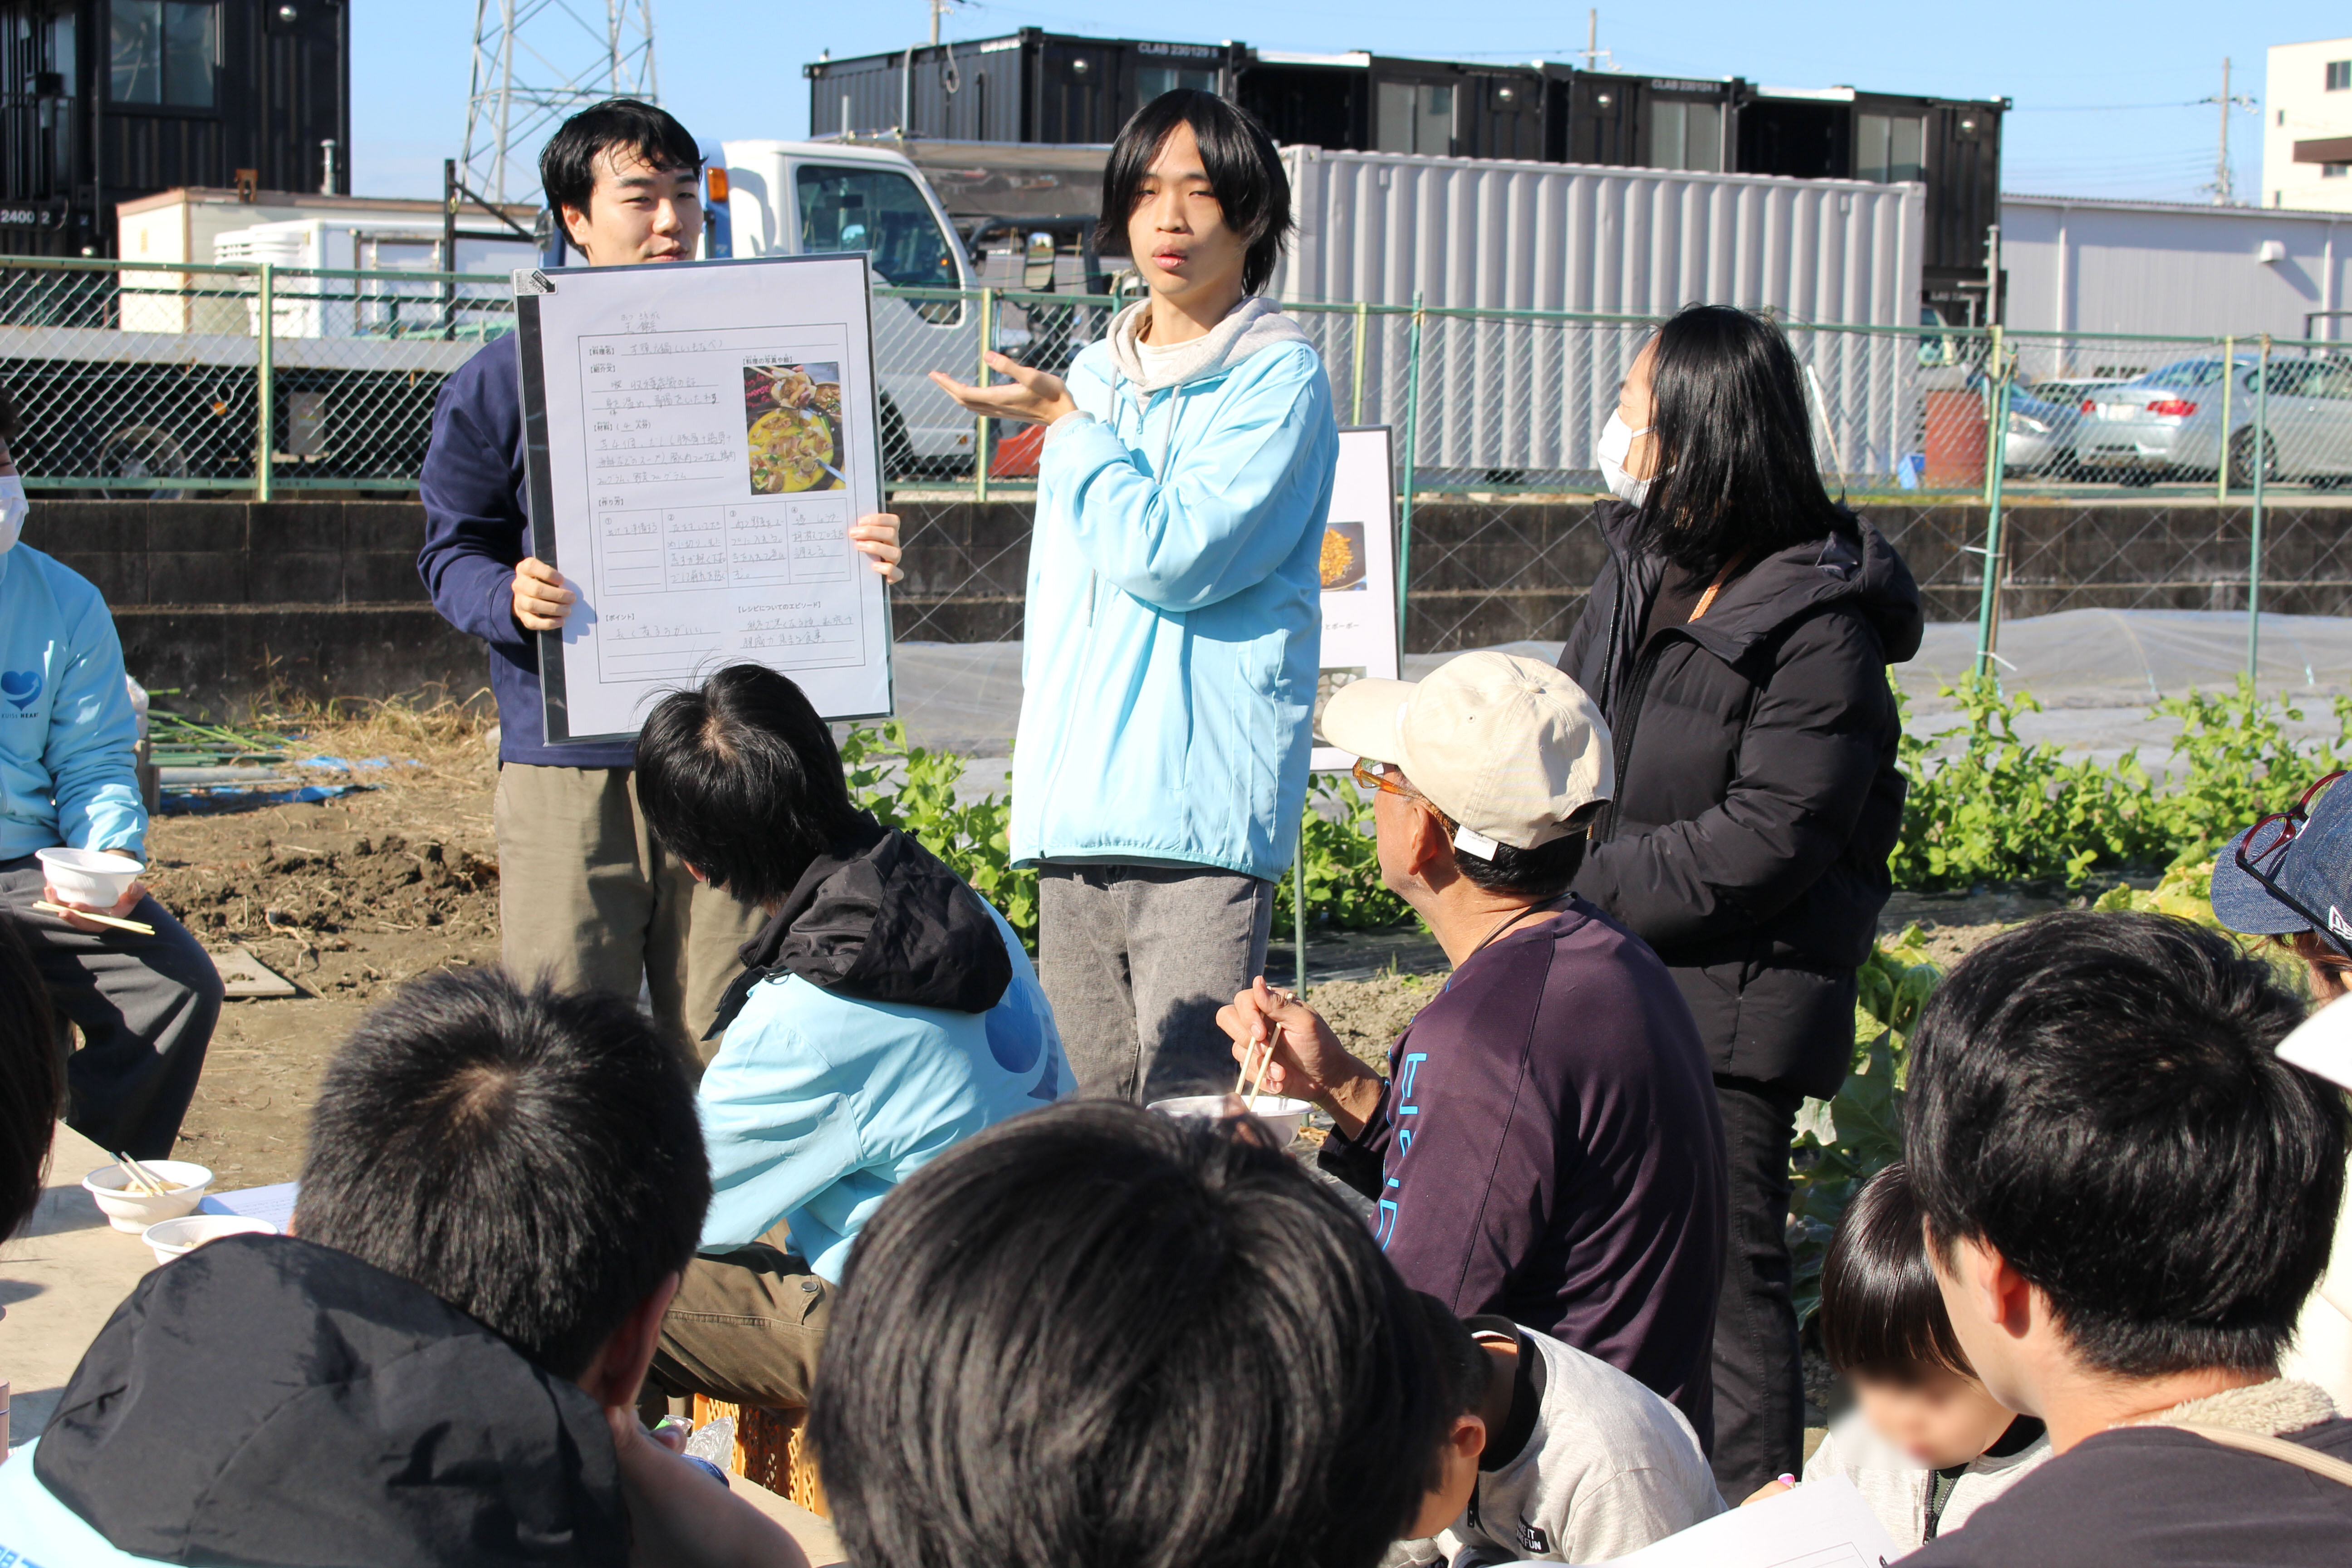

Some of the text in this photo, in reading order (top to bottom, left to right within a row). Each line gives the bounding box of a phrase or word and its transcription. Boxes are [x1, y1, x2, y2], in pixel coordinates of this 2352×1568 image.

[1138, 42, 1169, 55] CLAB
[1, 209, 35, 223] 2400
[1528, 1529, 1535, 1539] IT
[1524, 1537, 1542, 1550] FUN
